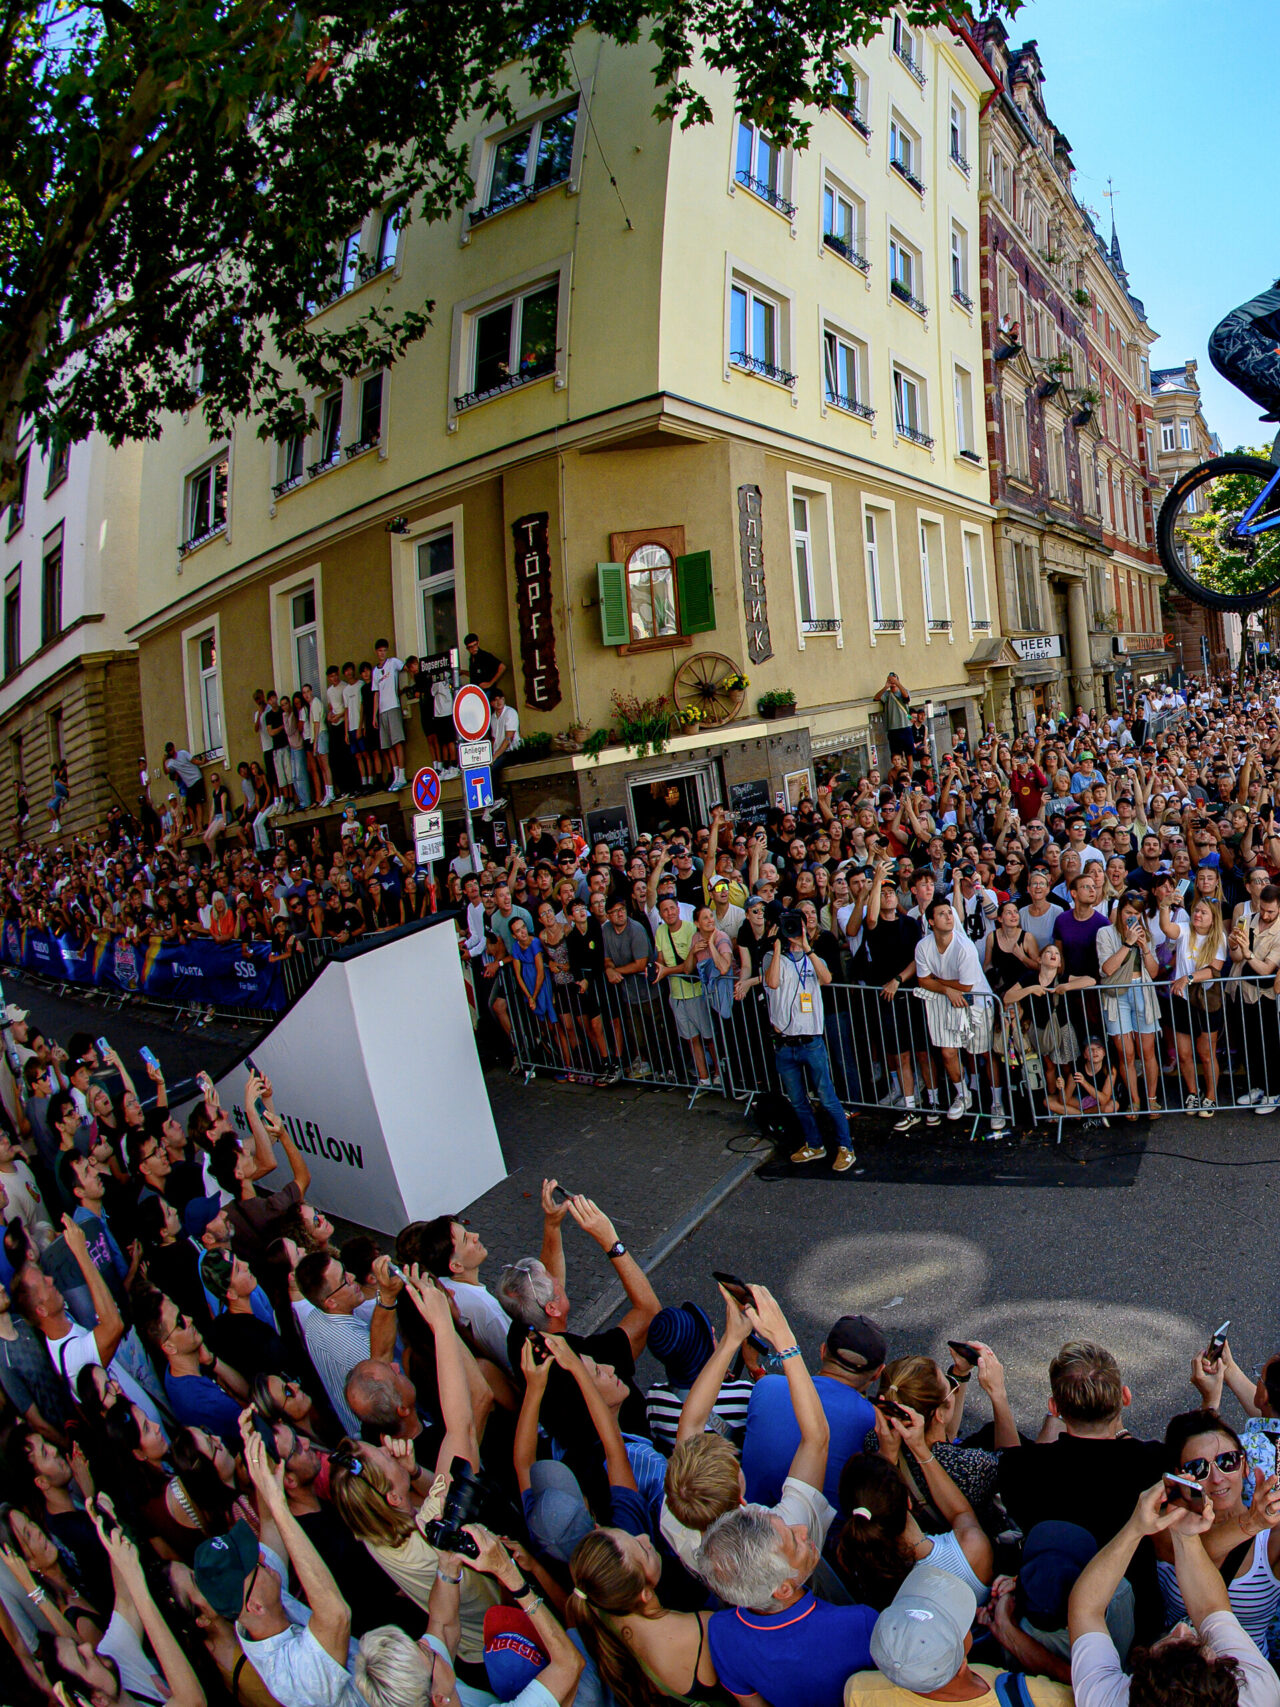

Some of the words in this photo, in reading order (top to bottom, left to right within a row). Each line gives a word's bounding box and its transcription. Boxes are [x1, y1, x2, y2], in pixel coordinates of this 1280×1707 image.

[521, 520, 548, 702] TÖPFLE
[1020, 637, 1052, 651] HEER
[1024, 650, 1049, 660] Frisör
[420, 656, 450, 672] Bopserstr.
[463, 745, 488, 757] Anlieger
[471, 754, 482, 763] frei
[179, 966, 204, 977] VARTA
[234, 960, 257, 978] SSB
